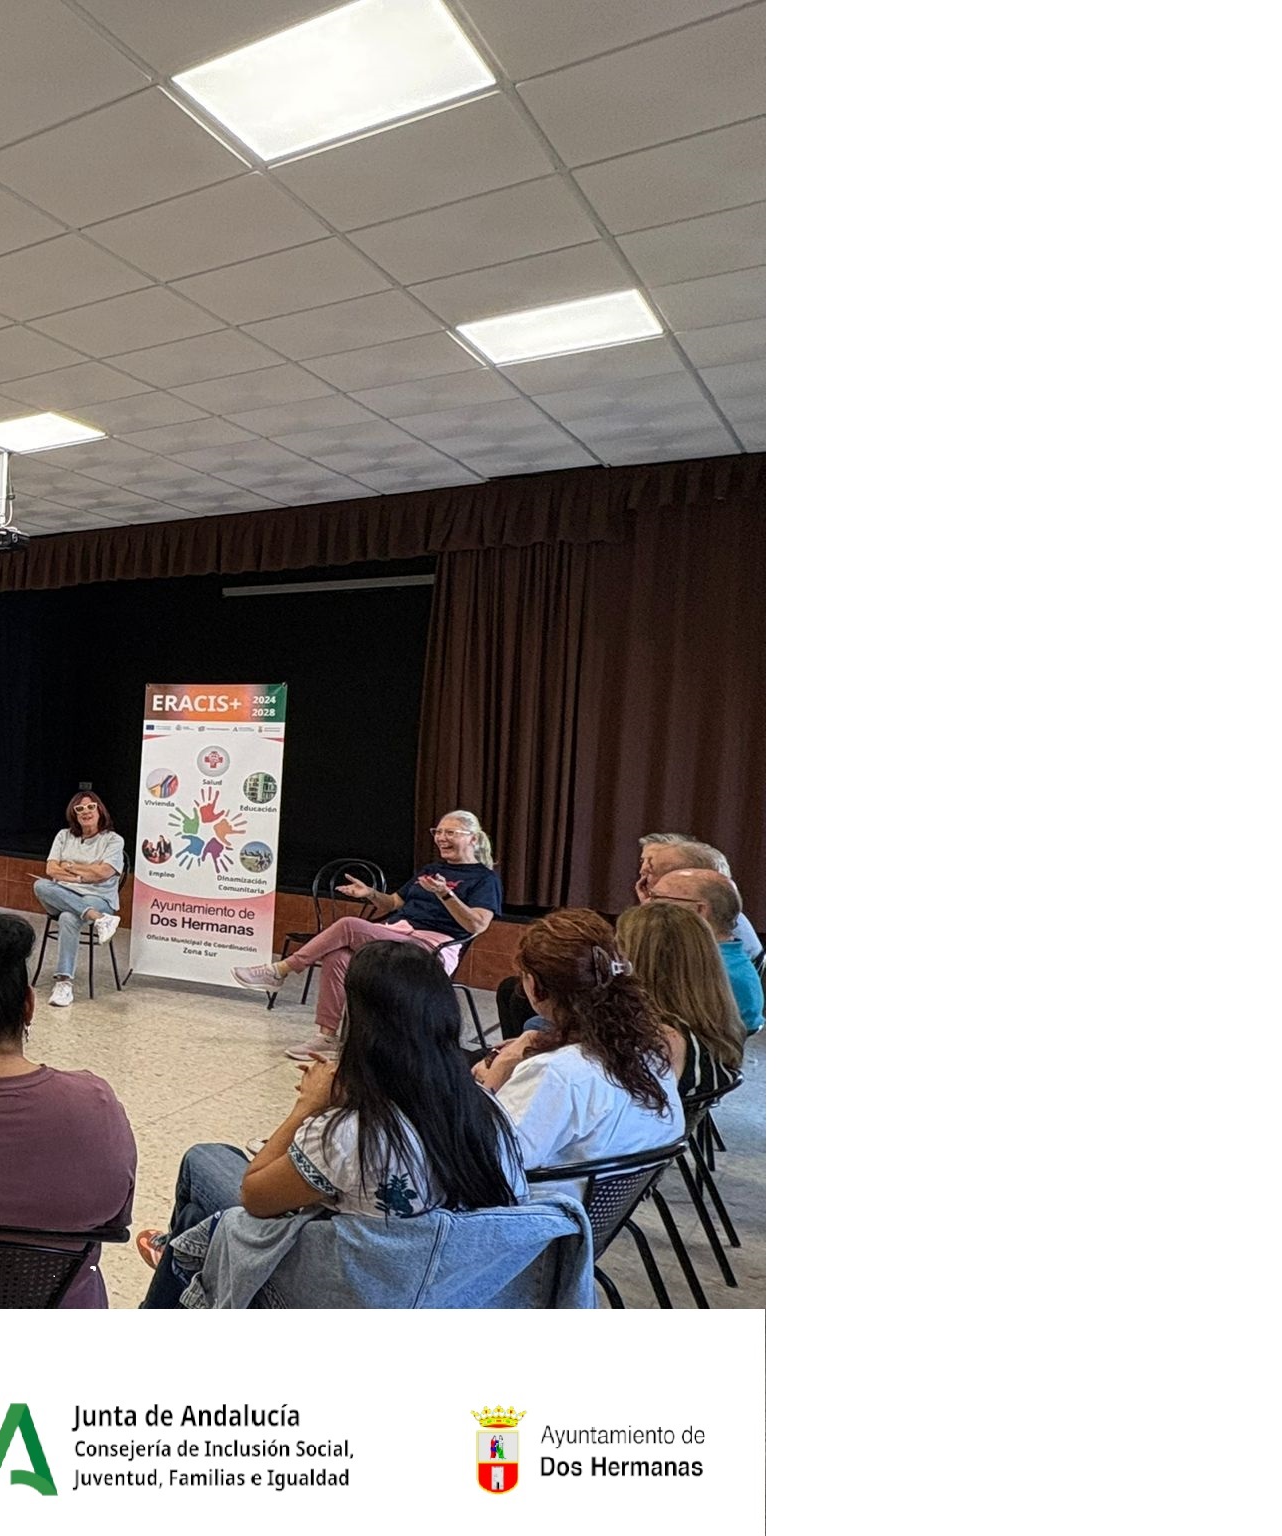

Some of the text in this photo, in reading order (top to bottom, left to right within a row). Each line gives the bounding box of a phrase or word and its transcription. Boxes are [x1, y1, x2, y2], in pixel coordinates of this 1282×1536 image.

[152, 694, 242, 712] ERACIS+
[252, 695, 276, 704] 2024
[251, 708, 276, 717] 2028
[202, 778, 222, 786] Salud
[144, 799, 175, 807] Vivienda
[240, 804, 278, 813] Educación
[149, 870, 175, 879] Empleo
[218, 884, 265, 895] Comunitaria
[150, 898, 255, 920] Ayuntamiento de
[150, 913, 254, 936] Dos Hermanas
[146, 934, 169, 942] Oficina
[183, 947, 218, 958] Zona Sur
